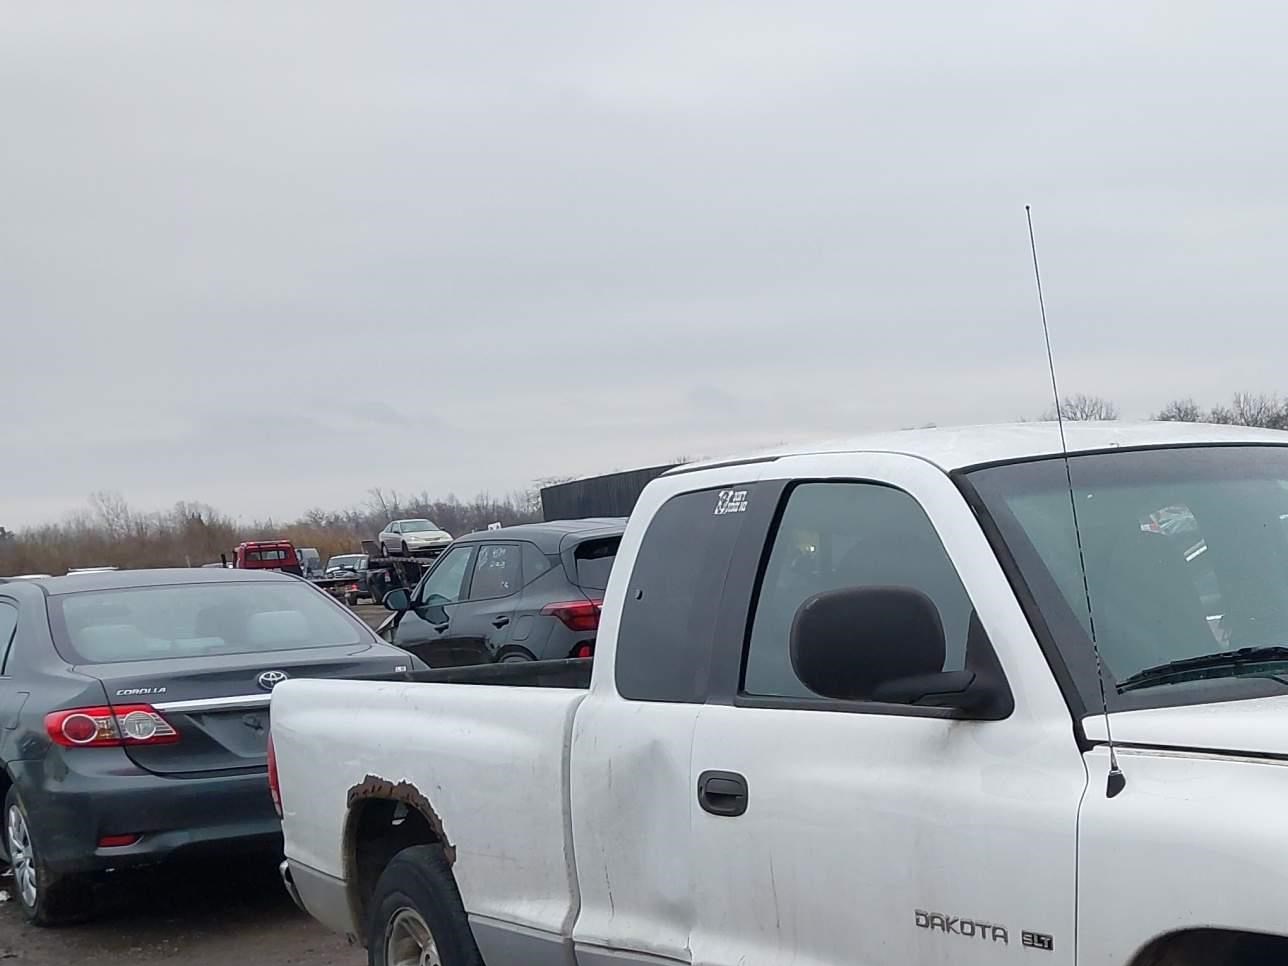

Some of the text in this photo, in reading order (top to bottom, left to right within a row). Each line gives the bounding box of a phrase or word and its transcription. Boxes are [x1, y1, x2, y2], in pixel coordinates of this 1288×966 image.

[116, 687, 167, 696] COROLLA
[914, 909, 1053, 950] DAKOTA SLT
